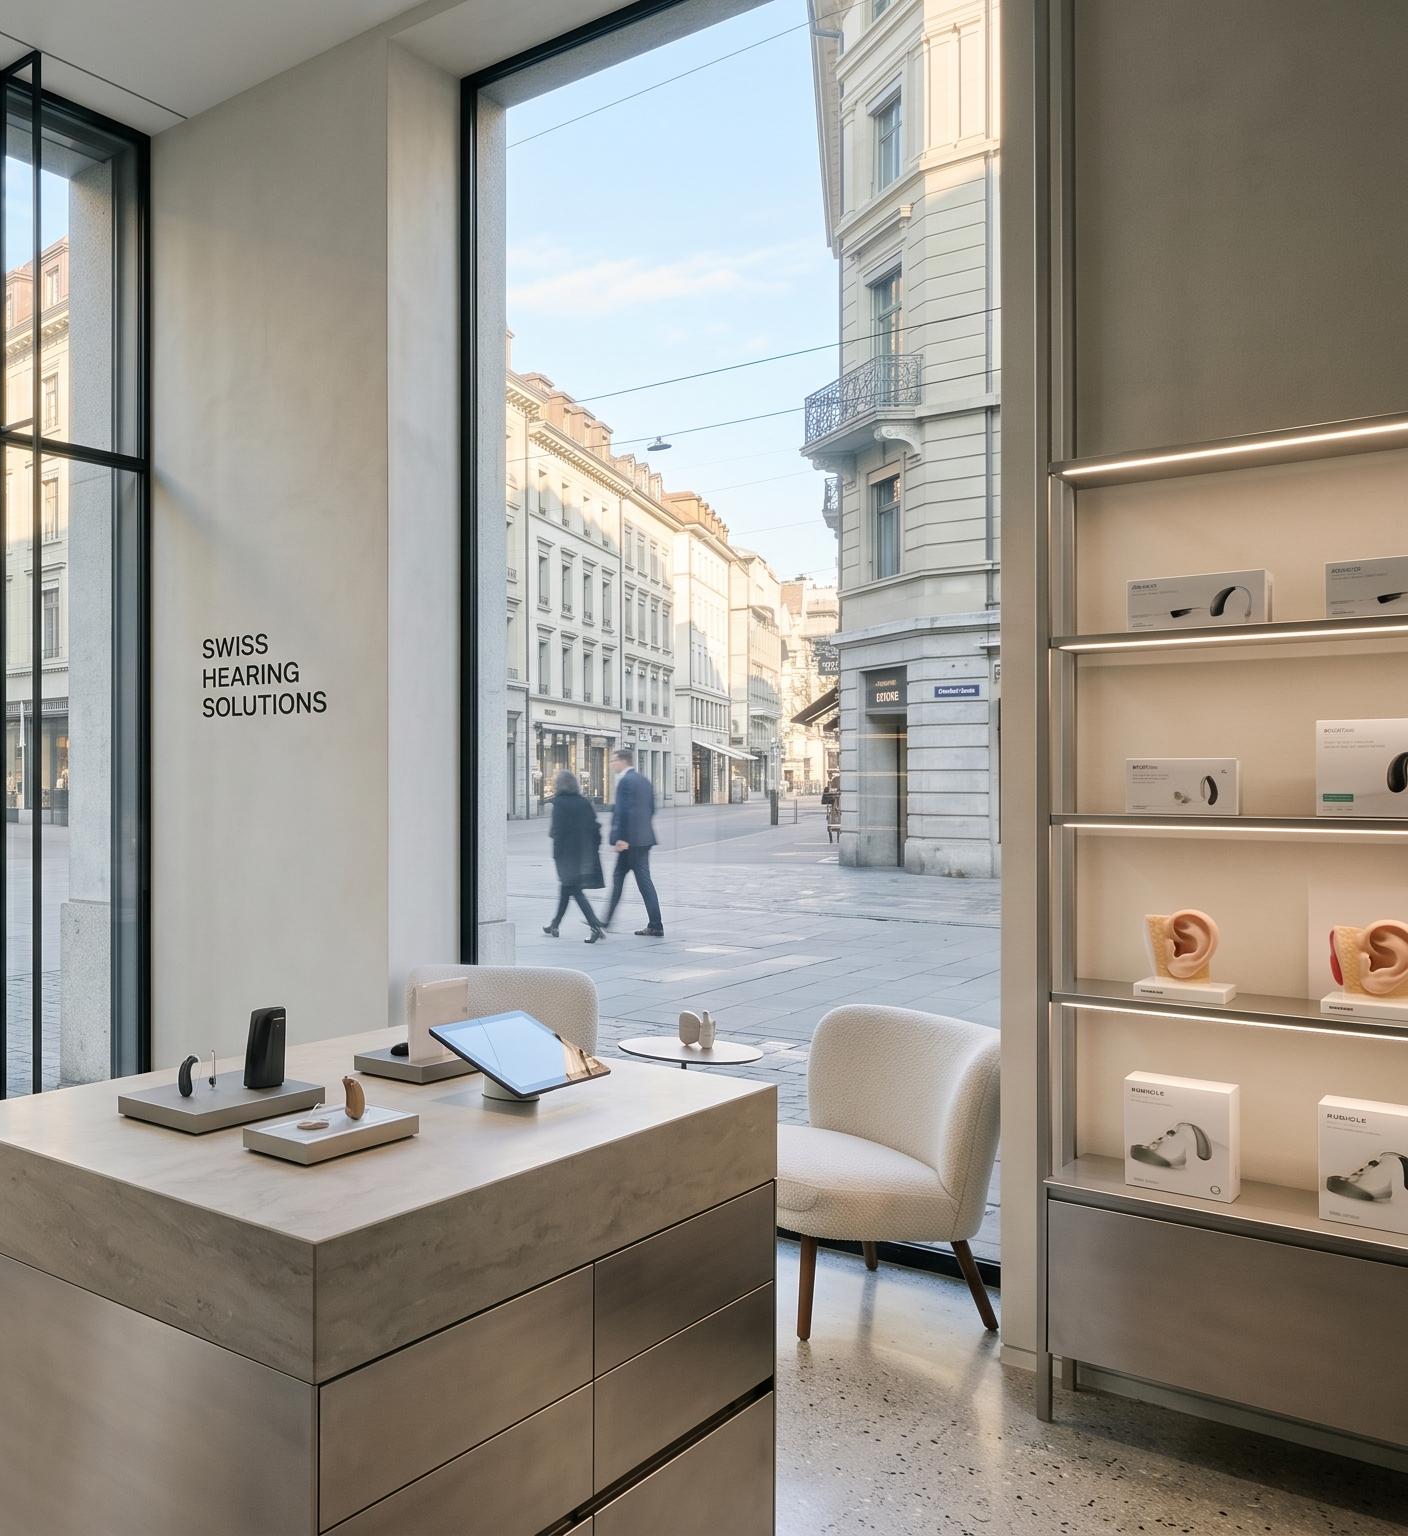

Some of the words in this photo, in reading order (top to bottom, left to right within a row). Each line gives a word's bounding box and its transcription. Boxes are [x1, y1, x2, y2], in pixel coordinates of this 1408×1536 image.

[202, 633, 269, 659] SWISS
[202, 661, 300, 689] HEARING
[202, 690, 328, 719] SOLUTIONS
